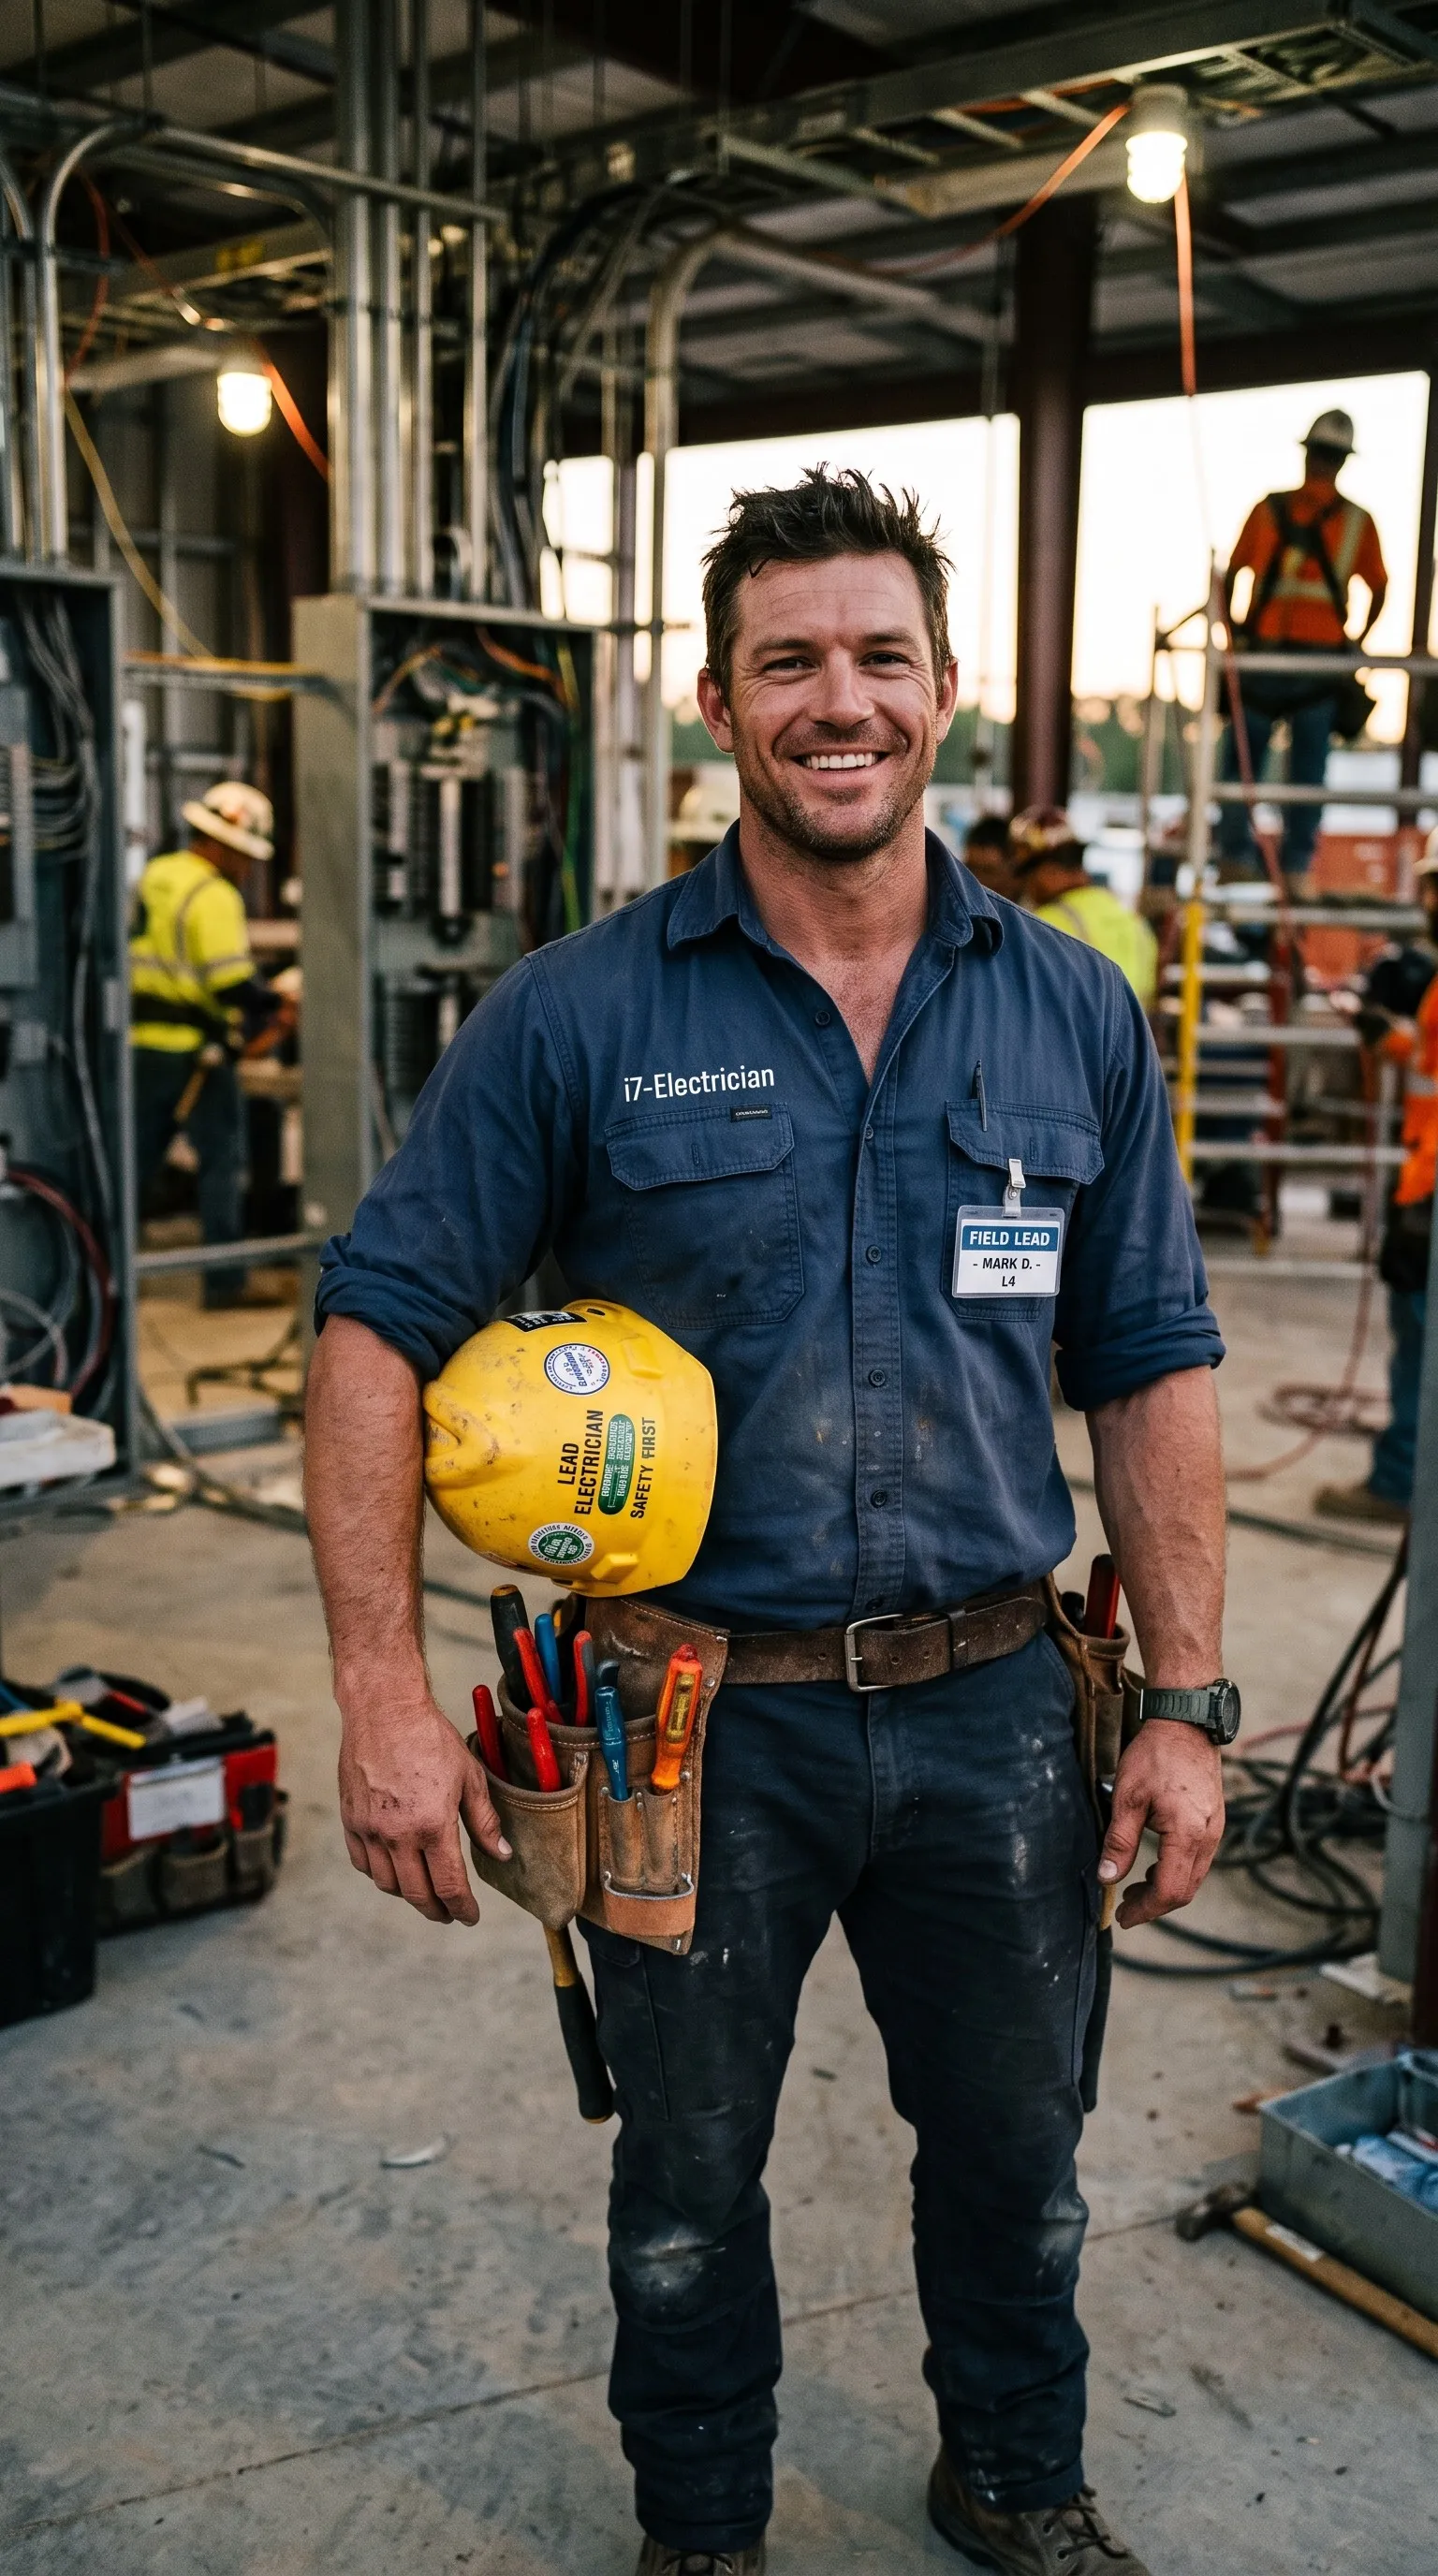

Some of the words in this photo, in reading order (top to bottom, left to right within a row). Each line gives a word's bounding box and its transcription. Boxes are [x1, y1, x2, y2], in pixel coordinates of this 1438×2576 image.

[624, 1065, 775, 1103] i7-Electrician
[969, 1231, 1009, 1245] FIELD
[1014, 1232, 1050, 1246] LEAD
[982, 1258, 1018, 1269] MARK
[1021, 1258, 1033, 1269] D.
[1002, 1276, 1016, 1287] L4
[641, 1416, 656, 1459] FIRST
[557, 1442, 580, 1486] LEAD
[574, 1410, 604, 1515] ELECTRICIAN
[630, 1464, 654, 1519] SAFETY
